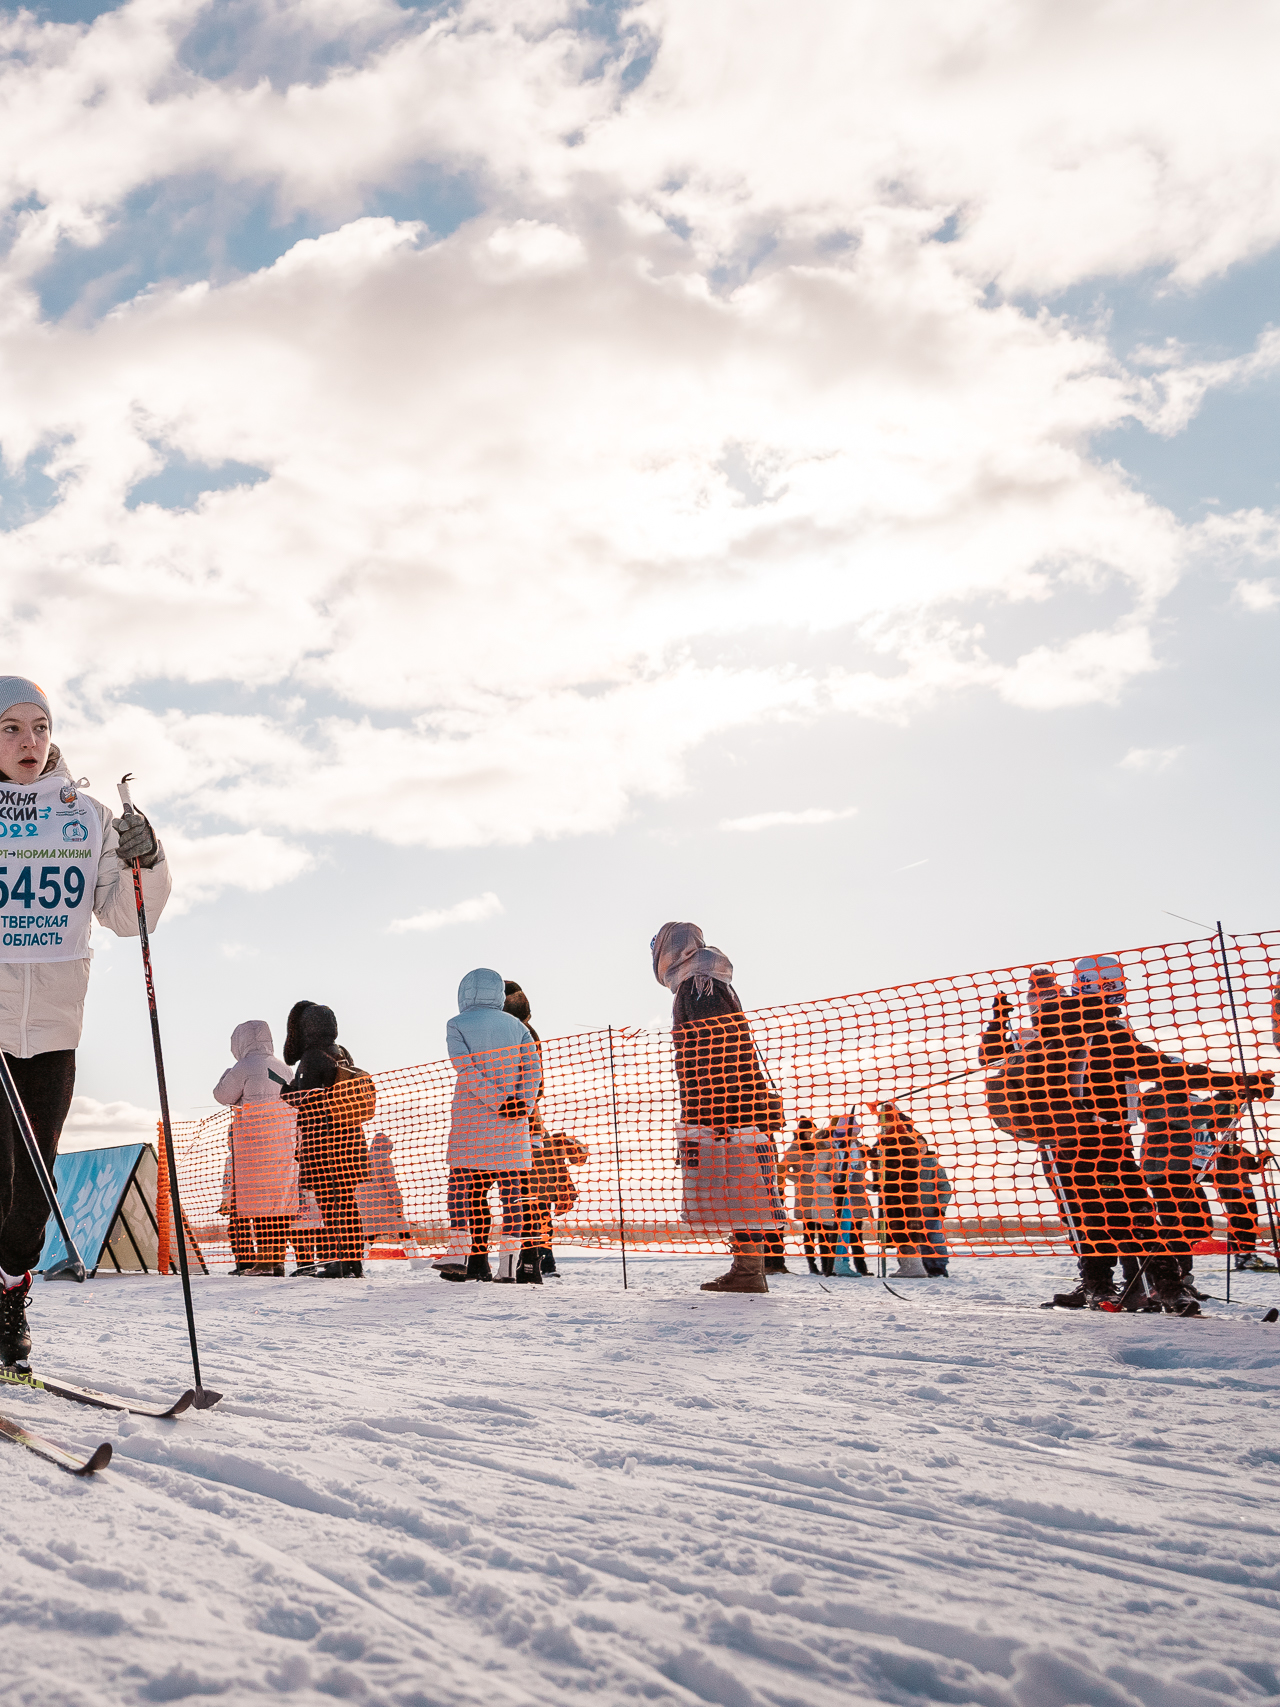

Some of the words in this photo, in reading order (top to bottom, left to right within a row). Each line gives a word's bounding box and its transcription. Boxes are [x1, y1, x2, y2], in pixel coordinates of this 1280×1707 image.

[16, 849, 56, 859] НОРМА
[57, 848, 92, 859] ЖИЗНИ
[0, 914, 69, 929] ТВЕРСКАЯ
[2, 932, 63, 947] ОБЛАСТЬ
